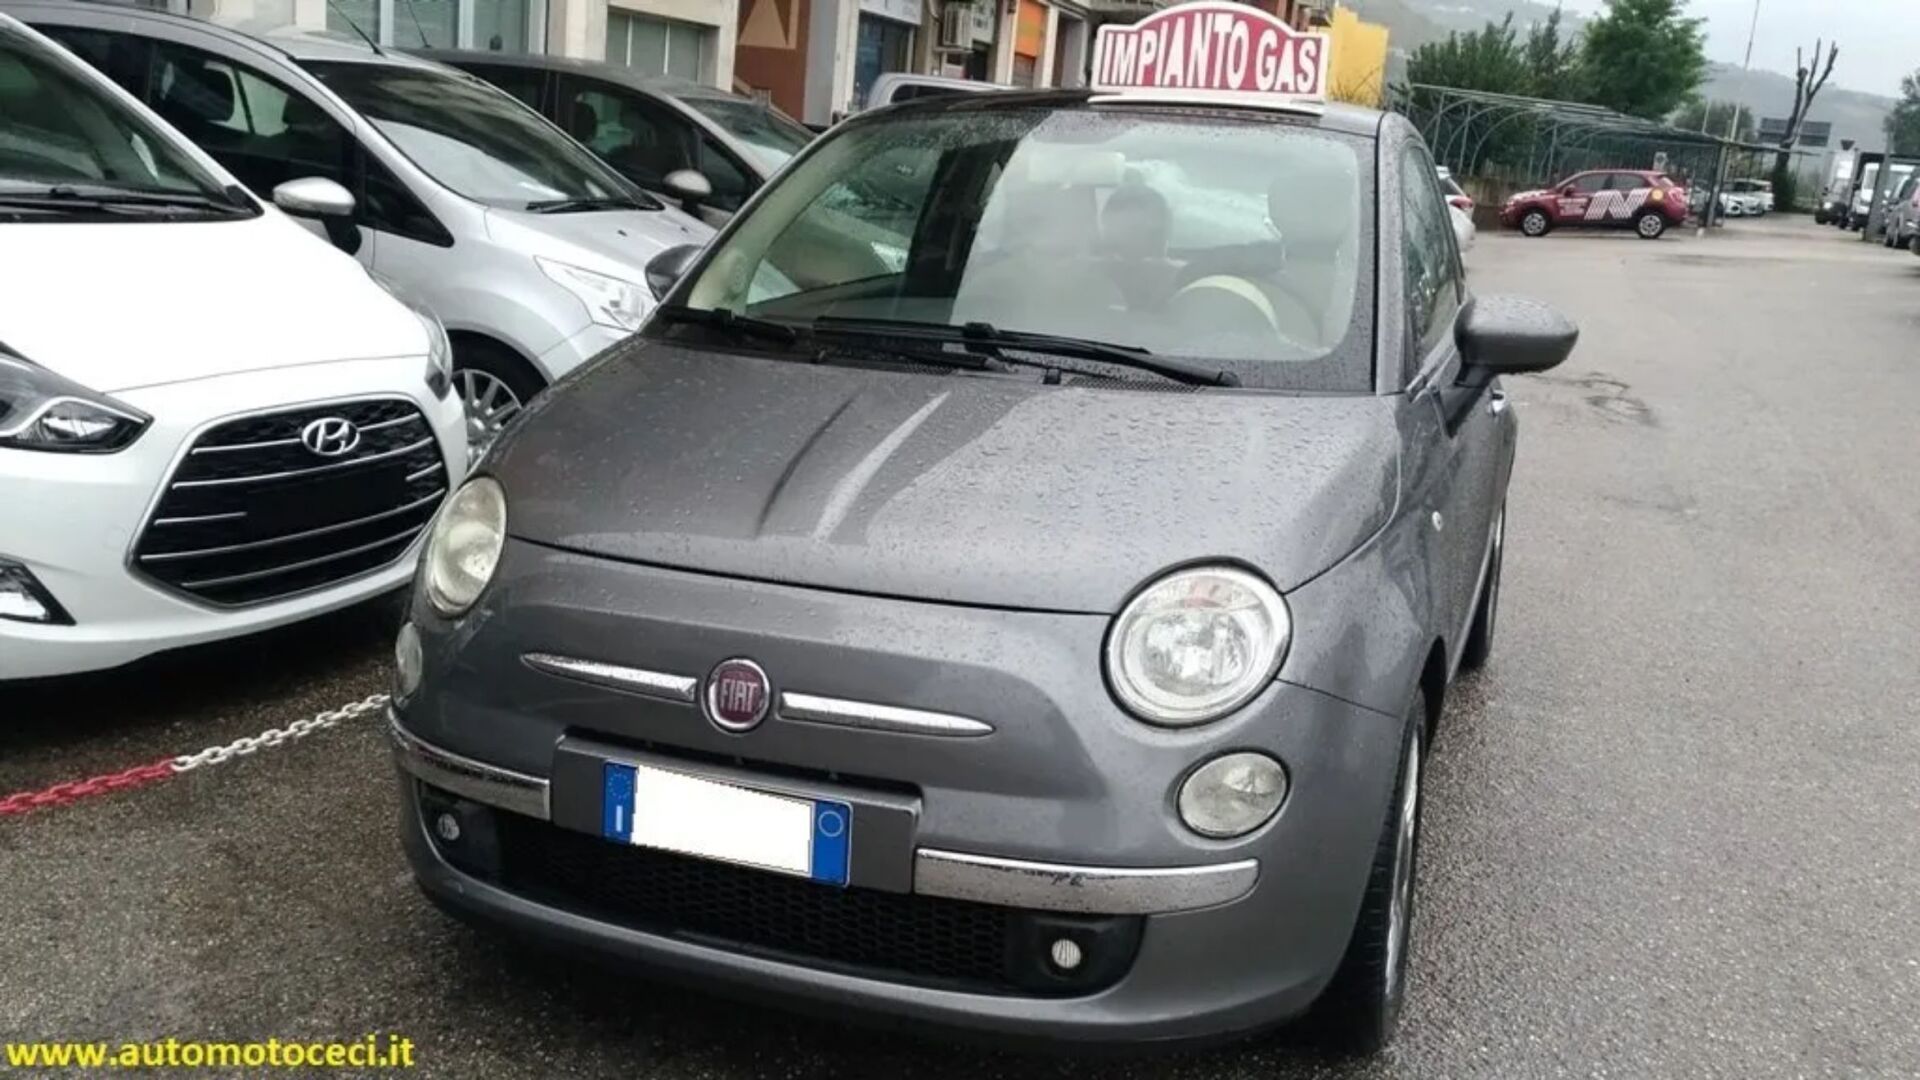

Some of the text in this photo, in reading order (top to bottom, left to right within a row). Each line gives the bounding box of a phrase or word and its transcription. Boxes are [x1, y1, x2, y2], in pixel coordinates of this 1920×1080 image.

[1101, 12, 1316, 93] IMPIANTO GAS
[720, 678, 759, 712] FIAT
